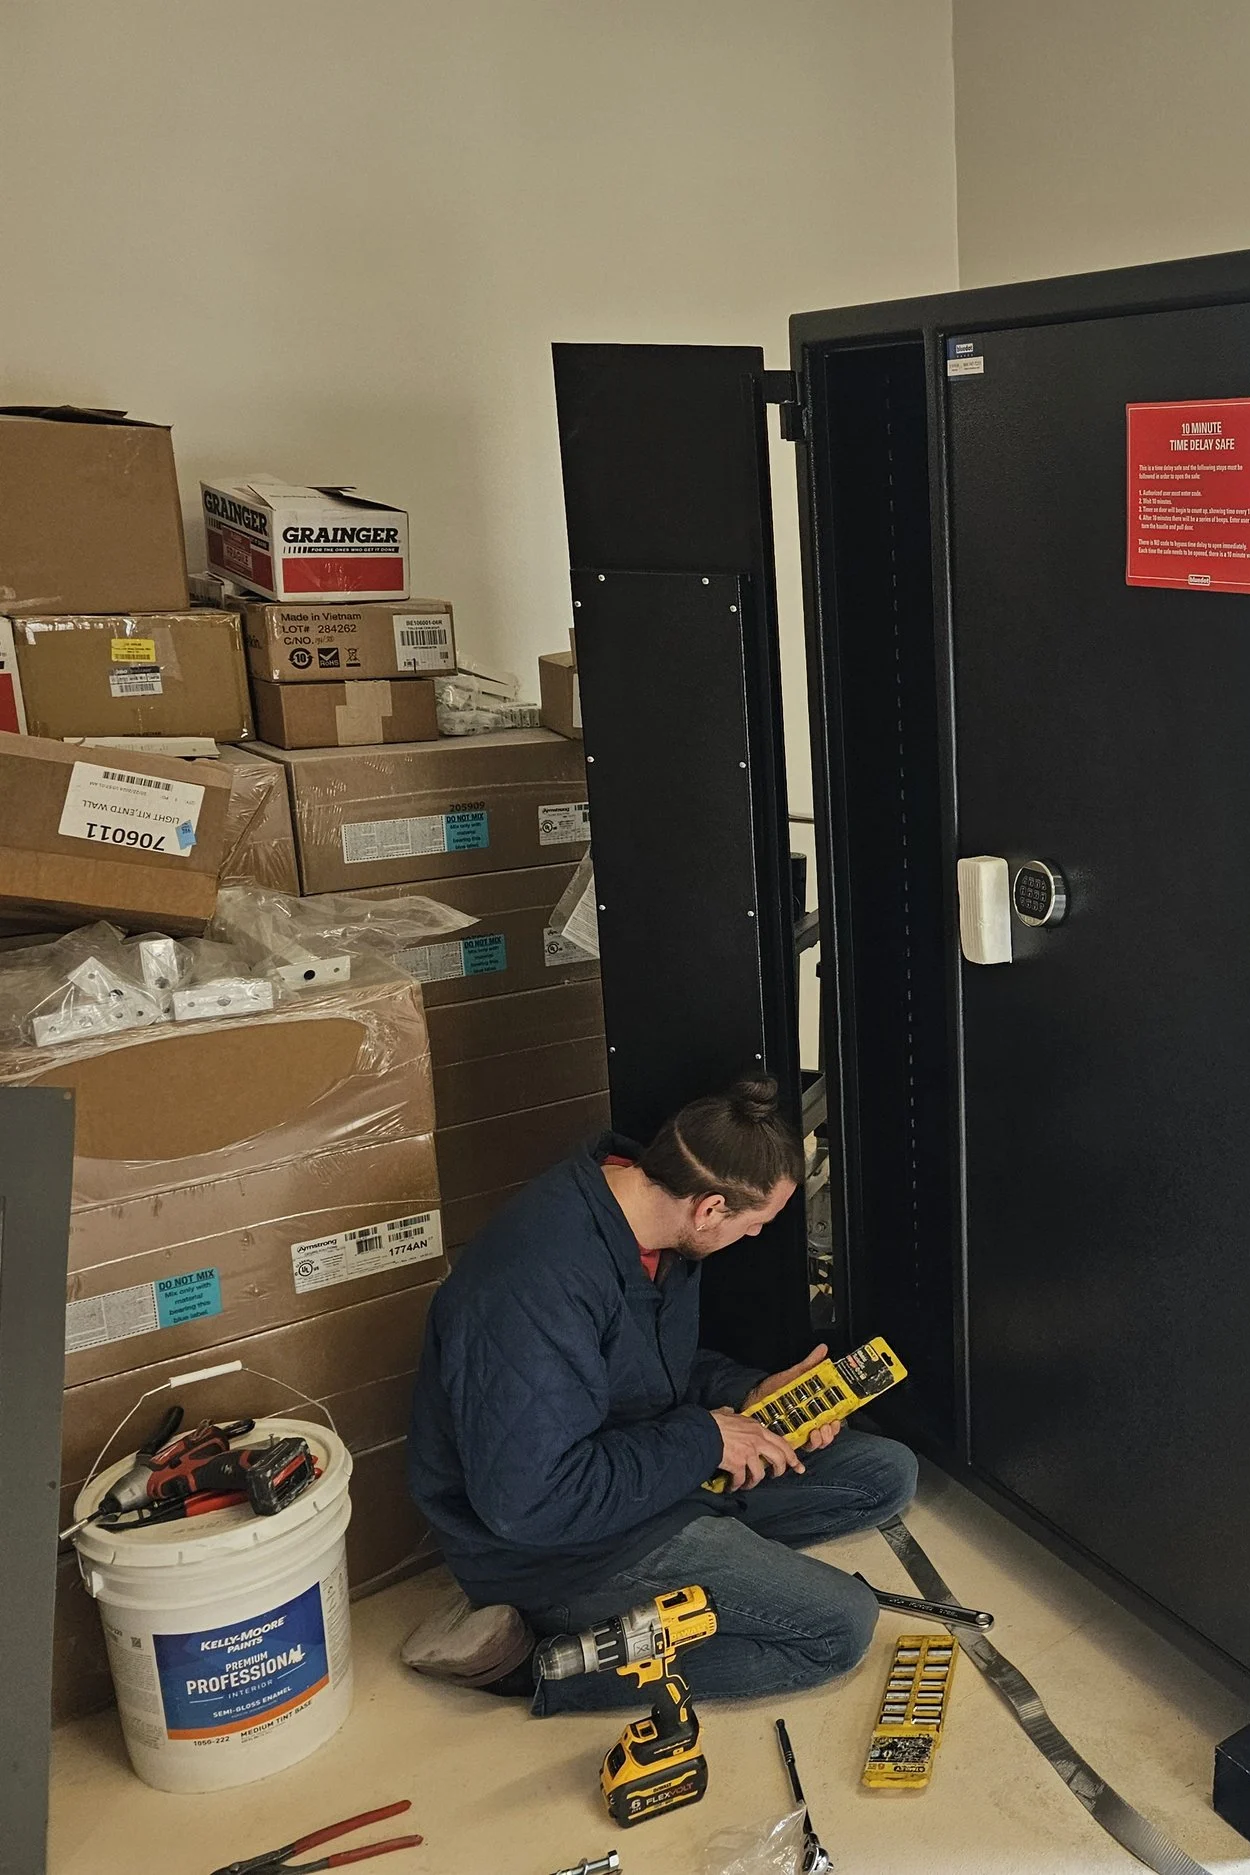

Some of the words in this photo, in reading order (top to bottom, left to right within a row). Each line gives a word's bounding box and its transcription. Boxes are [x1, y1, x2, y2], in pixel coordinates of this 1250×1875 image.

[1182, 424, 1189, 434] 10
[1192, 422, 1222, 434] MINUTE
[1170, 440, 1188, 450] TIME
[1190, 439, 1214, 450] DELAY
[1215, 439, 1235, 450] SAFE
[203, 490, 268, 536] GRAINGER
[282, 527, 399, 543] GRAINGER
[281, 613, 308, 621] Made
[282, 625, 309, 633] LOT#
[318, 624, 356, 633] 284262
[284, 637, 314, 645] C/NO.
[295, 654, 307, 663] 10
[82, 800, 108, 811] WALL
[110, 805, 152, 820] KIT,ENTD
[450, 801, 485, 812] 205909
[153, 815, 180, 824] LIGHT
[86, 822, 165, 851] 706011
[475, 939, 487, 947] NOT
[489, 936, 501, 945] MIX
[297, 1239, 337, 1253] Armstrong
[389, 1240, 428, 1256] 1774AN
[158, 1280, 172, 1291] DO
[174, 1274, 193, 1286] NOT
[196, 1269, 214, 1280] MIX
[175, 1293, 203, 1304] material
[169, 1304, 196, 1315] bearing
[200, 1618, 285, 1651] KELLY-MOORE
[227, 1636, 263, 1654] PAINTS
[225, 1651, 268, 1672] PREMIUM
[186, 1644, 304, 1695] PROFESSIONAL
[228, 1679, 272, 1699] INTERIOR
[213, 1699, 261, 1718] SEMI-GLOSS
[262, 1686, 292, 1703] ENAMEL
[240, 1721, 274, 1738] MEDIUM
[276, 1713, 293, 1725] TINT
[295, 1700, 312, 1715] BASE
[646, 1782, 694, 1805] FLEXVOLT
[631, 1799, 641, 1809] 6
